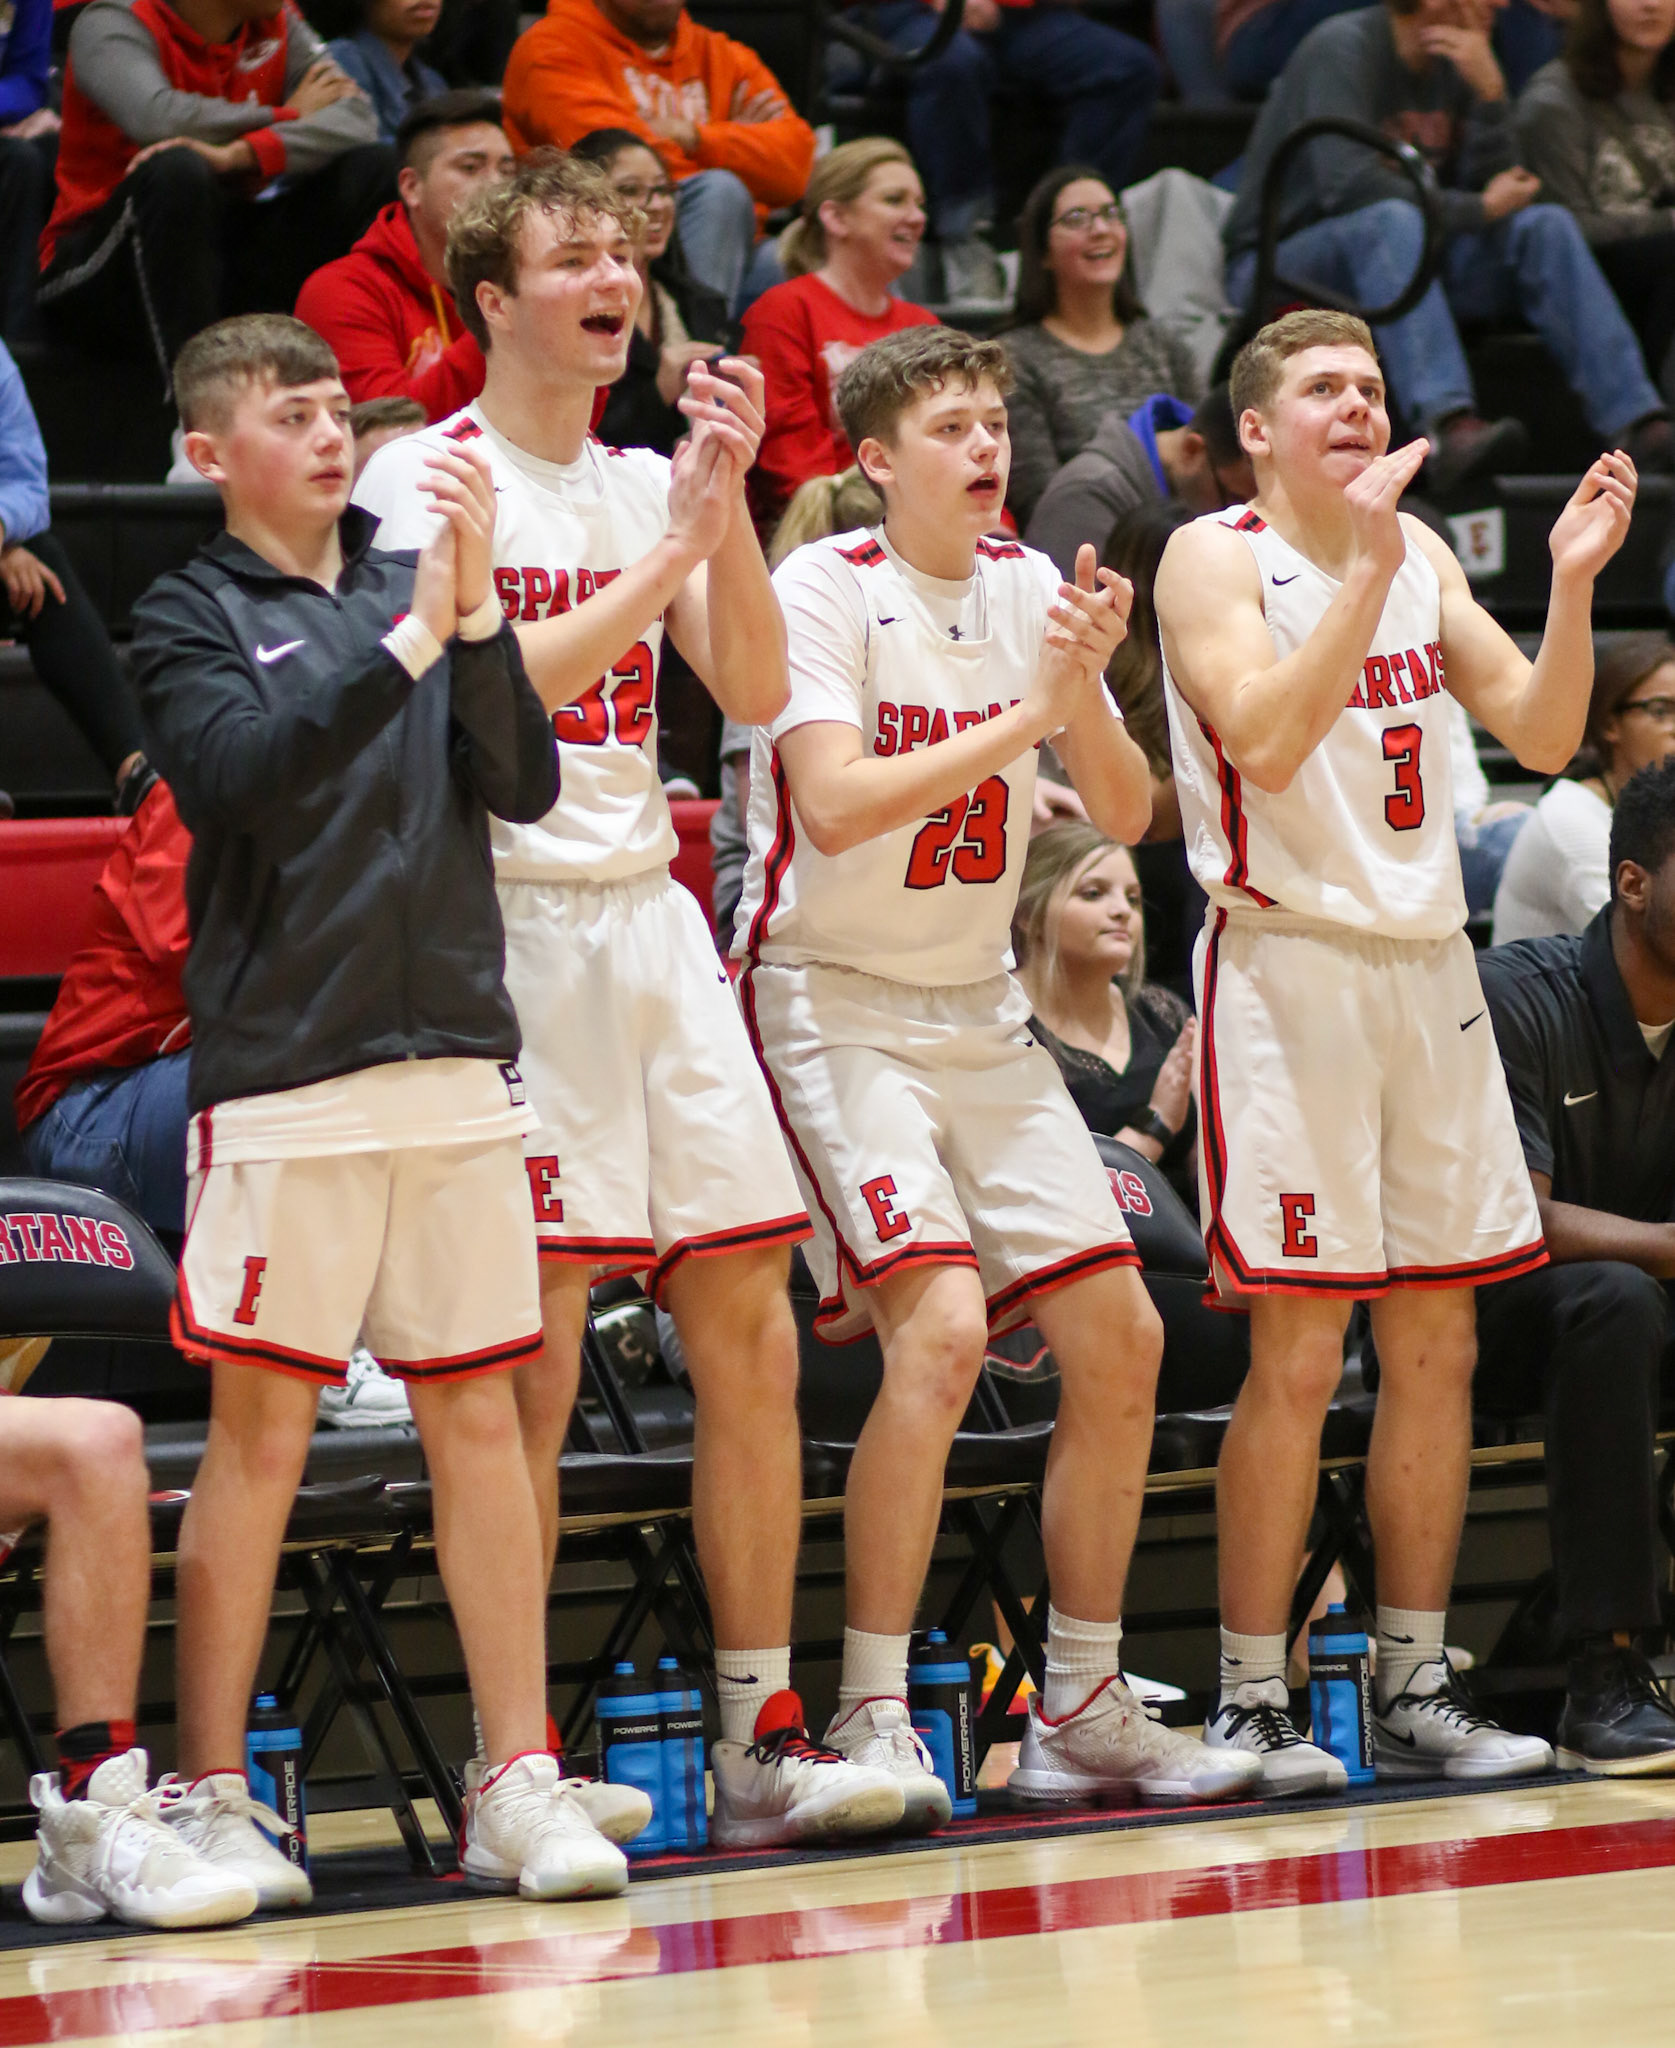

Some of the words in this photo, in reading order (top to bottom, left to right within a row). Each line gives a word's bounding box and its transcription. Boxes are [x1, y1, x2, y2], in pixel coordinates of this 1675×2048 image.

[551, 640, 655, 747] 32
[1381, 722, 1425, 831] 3
[903, 774, 1010, 890] 23
[524, 1155, 564, 1223] E
[859, 1174, 913, 1244] E
[1279, 1193, 1318, 1258] E
[958, 1686, 972, 1793] POWERADE
[1360, 1657, 1373, 1767] POWERADE
